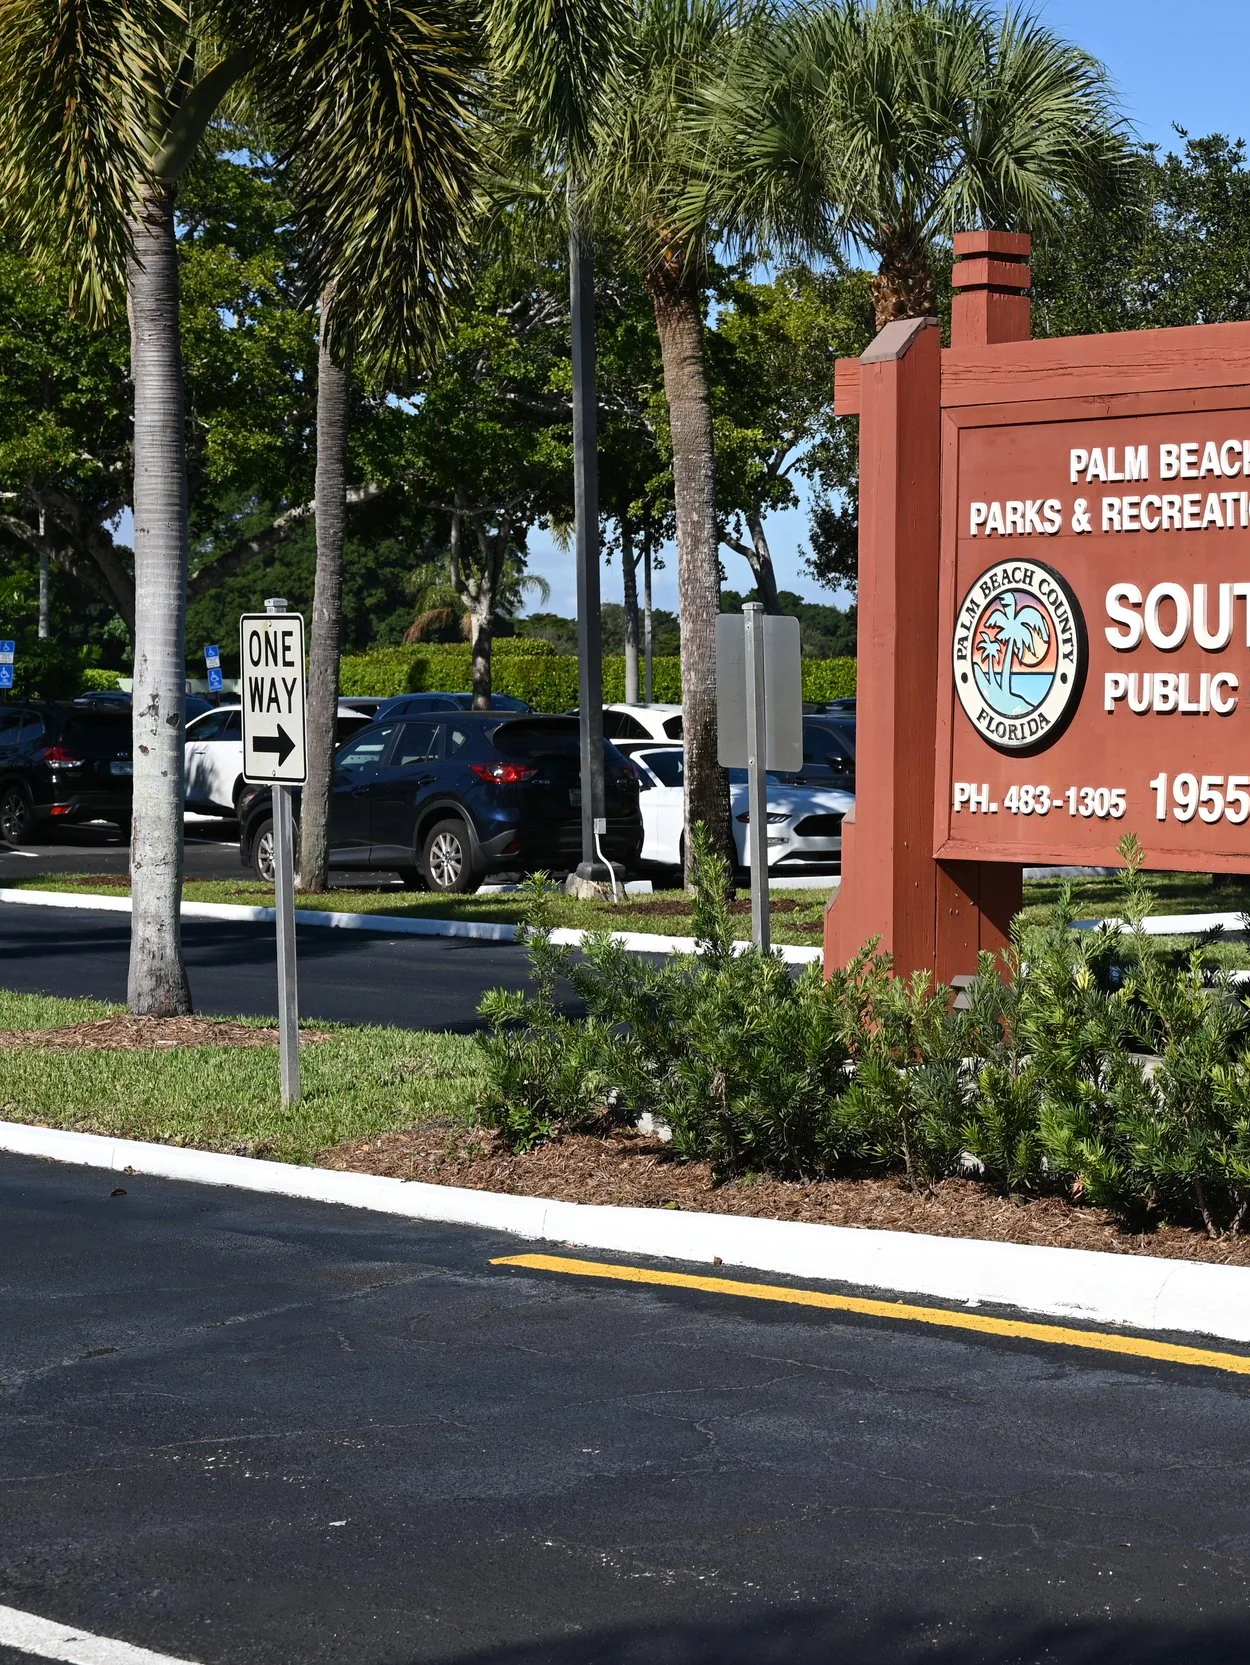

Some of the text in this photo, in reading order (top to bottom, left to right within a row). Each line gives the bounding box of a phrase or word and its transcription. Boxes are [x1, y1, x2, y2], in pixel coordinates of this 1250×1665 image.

[1070, 445, 1148, 482] PALM
[970, 499, 1062, 535] PARKS
[1072, 498, 1092, 532] &
[956, 568, 1074, 664] PALM BEACH COUNTY
[249, 630, 294, 667] ONE
[248, 677, 297, 713] WAY
[1104, 672, 1238, 712] PUBLIC
[976, 707, 1051, 740] FLORIDA
[954, 783, 1126, 817] PH. 483-1305
